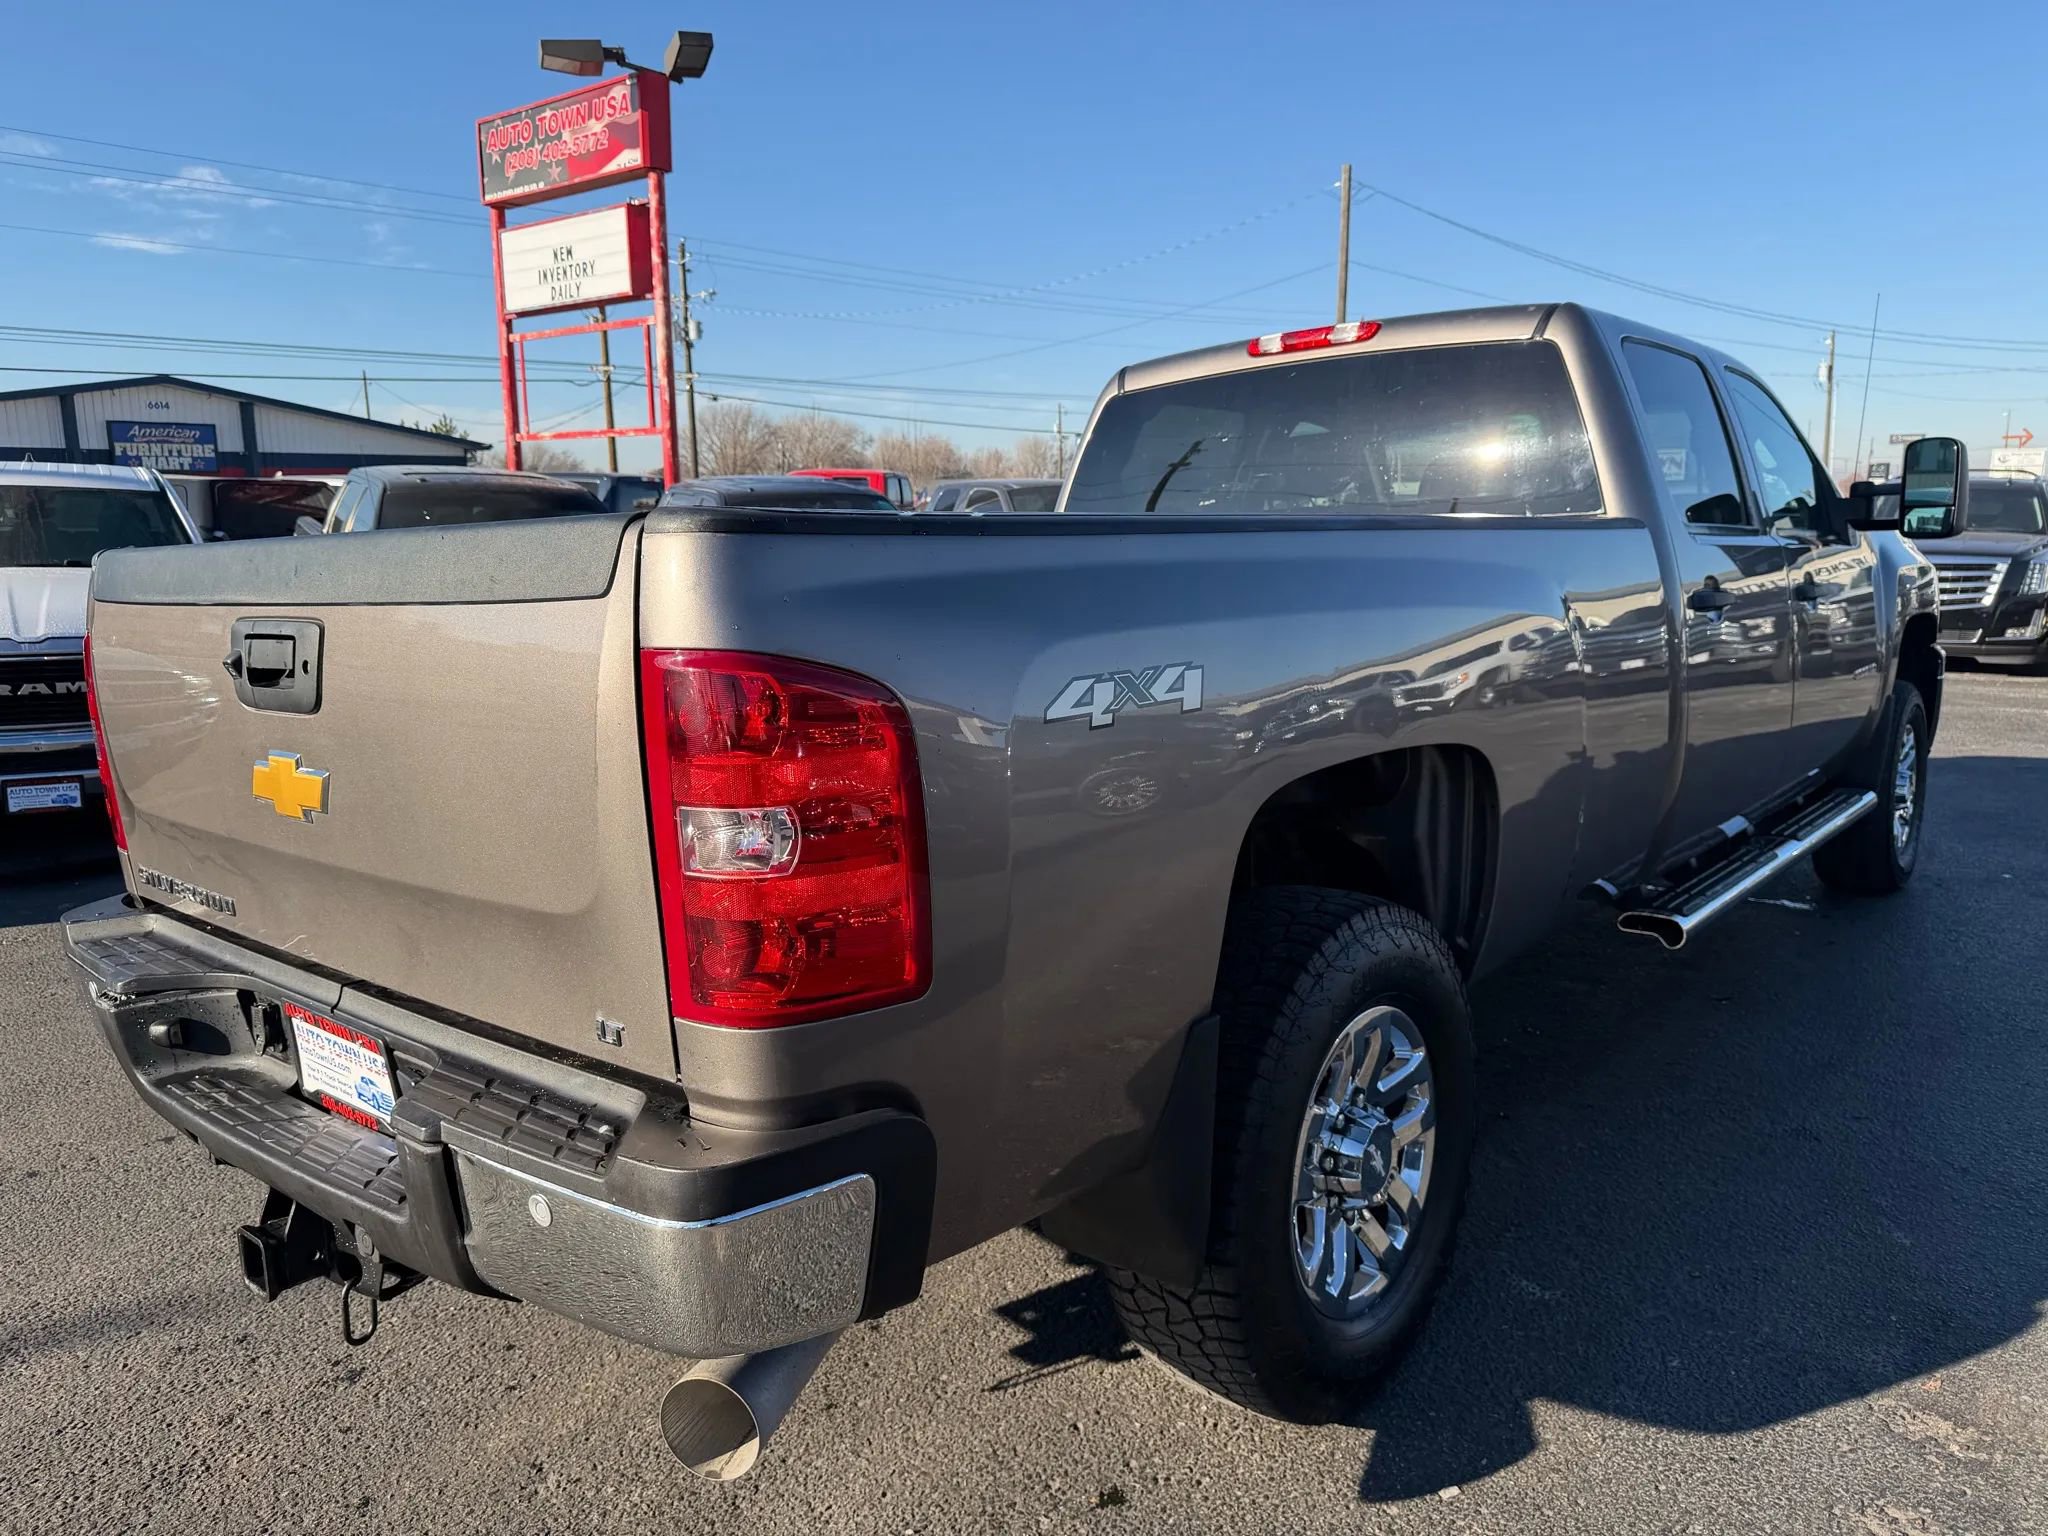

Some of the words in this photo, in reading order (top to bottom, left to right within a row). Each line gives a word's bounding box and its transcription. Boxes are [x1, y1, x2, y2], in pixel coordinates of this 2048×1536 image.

[486, 119, 533, 153] AUTO
[536, 102, 589, 139] TOWN
[592, 90, 632, 122] USA
[504, 147, 540, 177] (208)
[542, 128, 609, 162] 402-5772
[538, 260, 596, 285] INVENTORY
[551, 281, 582, 301] DAILY
[147, 401, 170, 410] 6614
[128, 424, 200, 439] American
[113, 442, 216, 458] FURNITURE
[141, 456, 193, 471] MART
[9, 787, 33, 796] AUTO
[34, 786, 60, 794] TOWN
[62, 784, 80, 792] USA
[284, 1002, 316, 1025] AUTO
[317, 1015, 352, 1044] TOWN
[352, 1032, 381, 1056] USA
